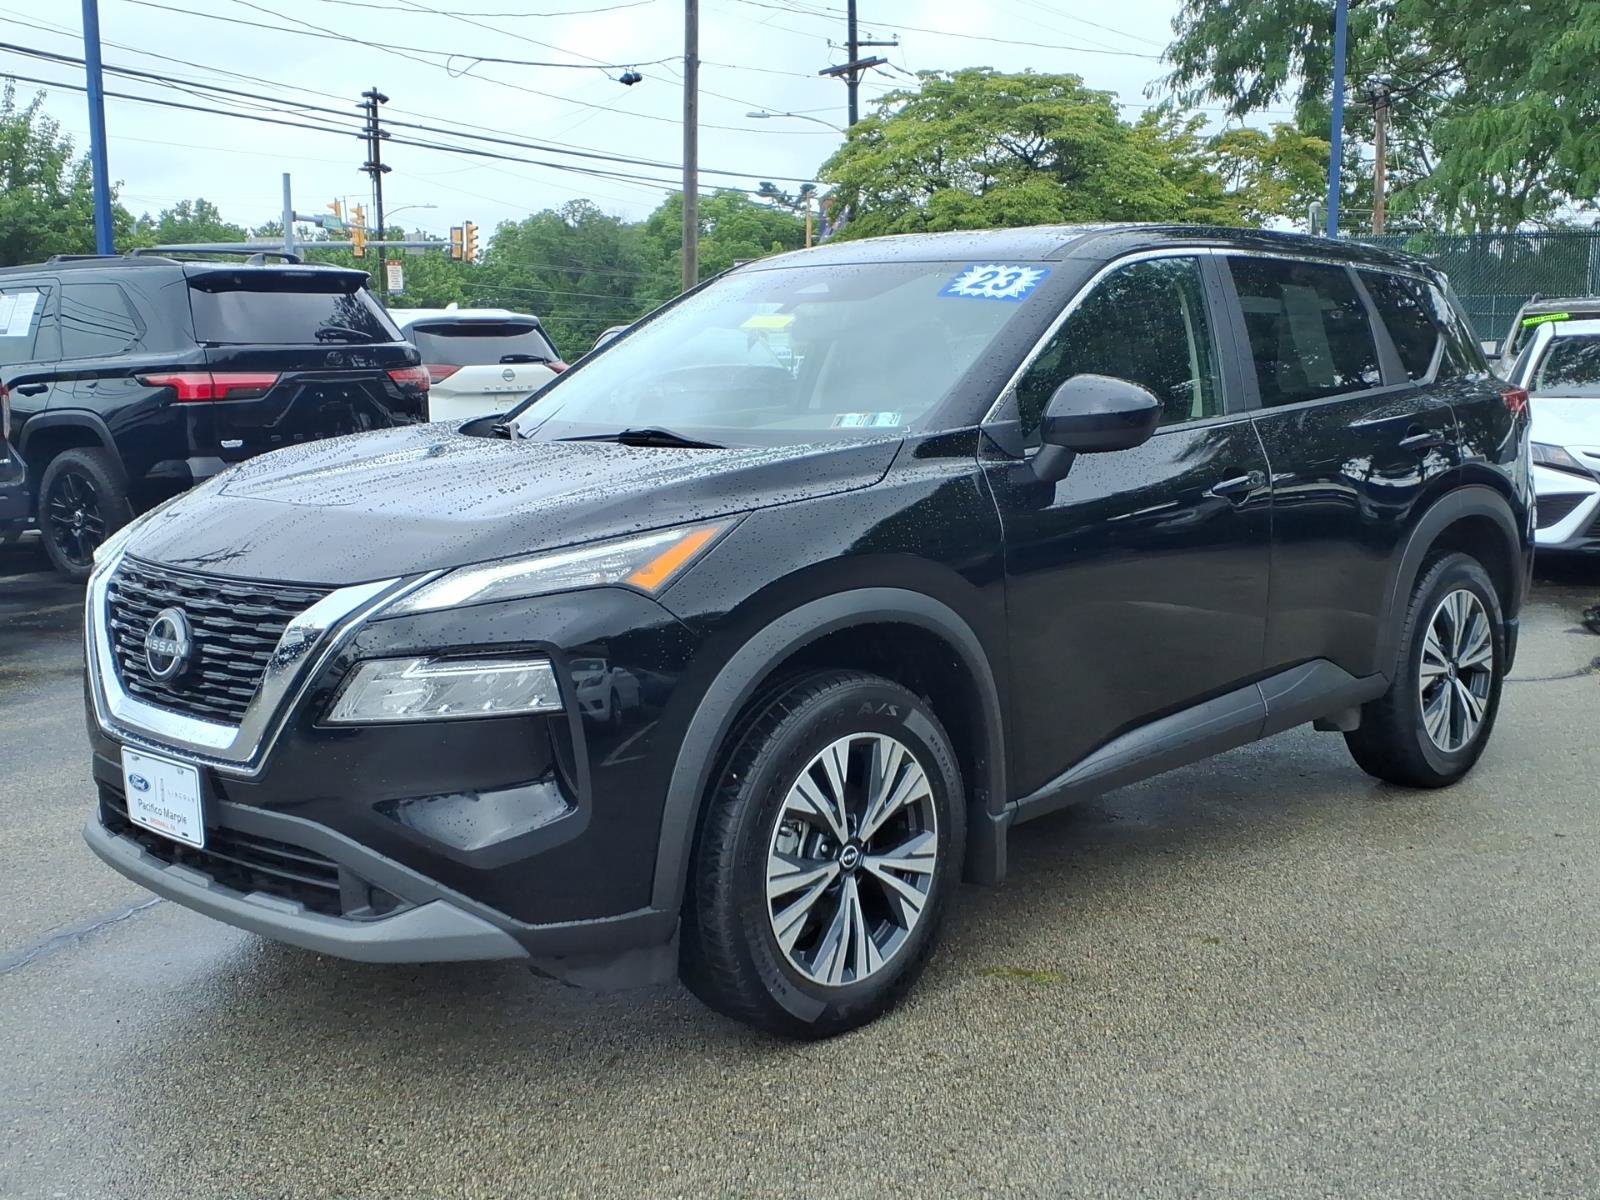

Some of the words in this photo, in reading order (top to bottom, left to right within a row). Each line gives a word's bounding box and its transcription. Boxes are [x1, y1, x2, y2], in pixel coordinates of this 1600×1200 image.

[966, 270, 1023, 291] 23
[146, 639, 186, 655] NISSAN
[138, 798, 163, 816] Pacifico
[163, 807, 187, 825] Marple
